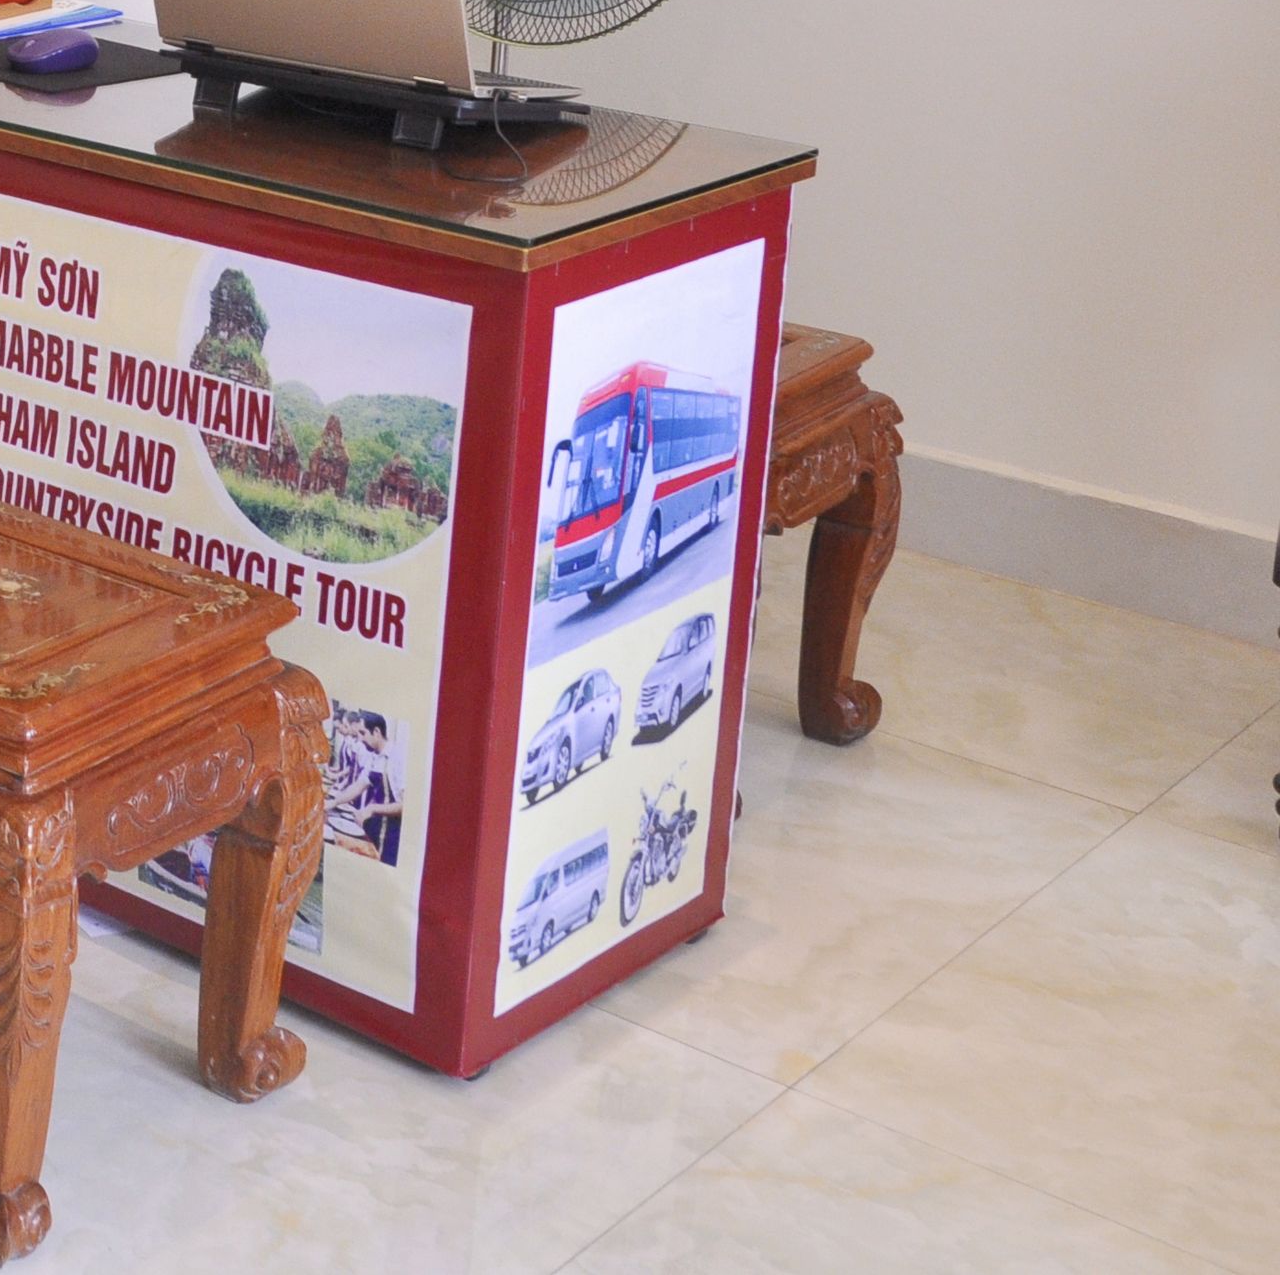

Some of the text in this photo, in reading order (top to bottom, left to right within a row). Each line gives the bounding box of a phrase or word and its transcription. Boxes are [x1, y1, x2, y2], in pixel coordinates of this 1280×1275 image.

[37, 256, 100, 320] SƠN
[106, 351, 271, 446] MOUNTAIN
[65, 415, 177, 495] ISLAND
[316, 570, 406, 649] TOUR
